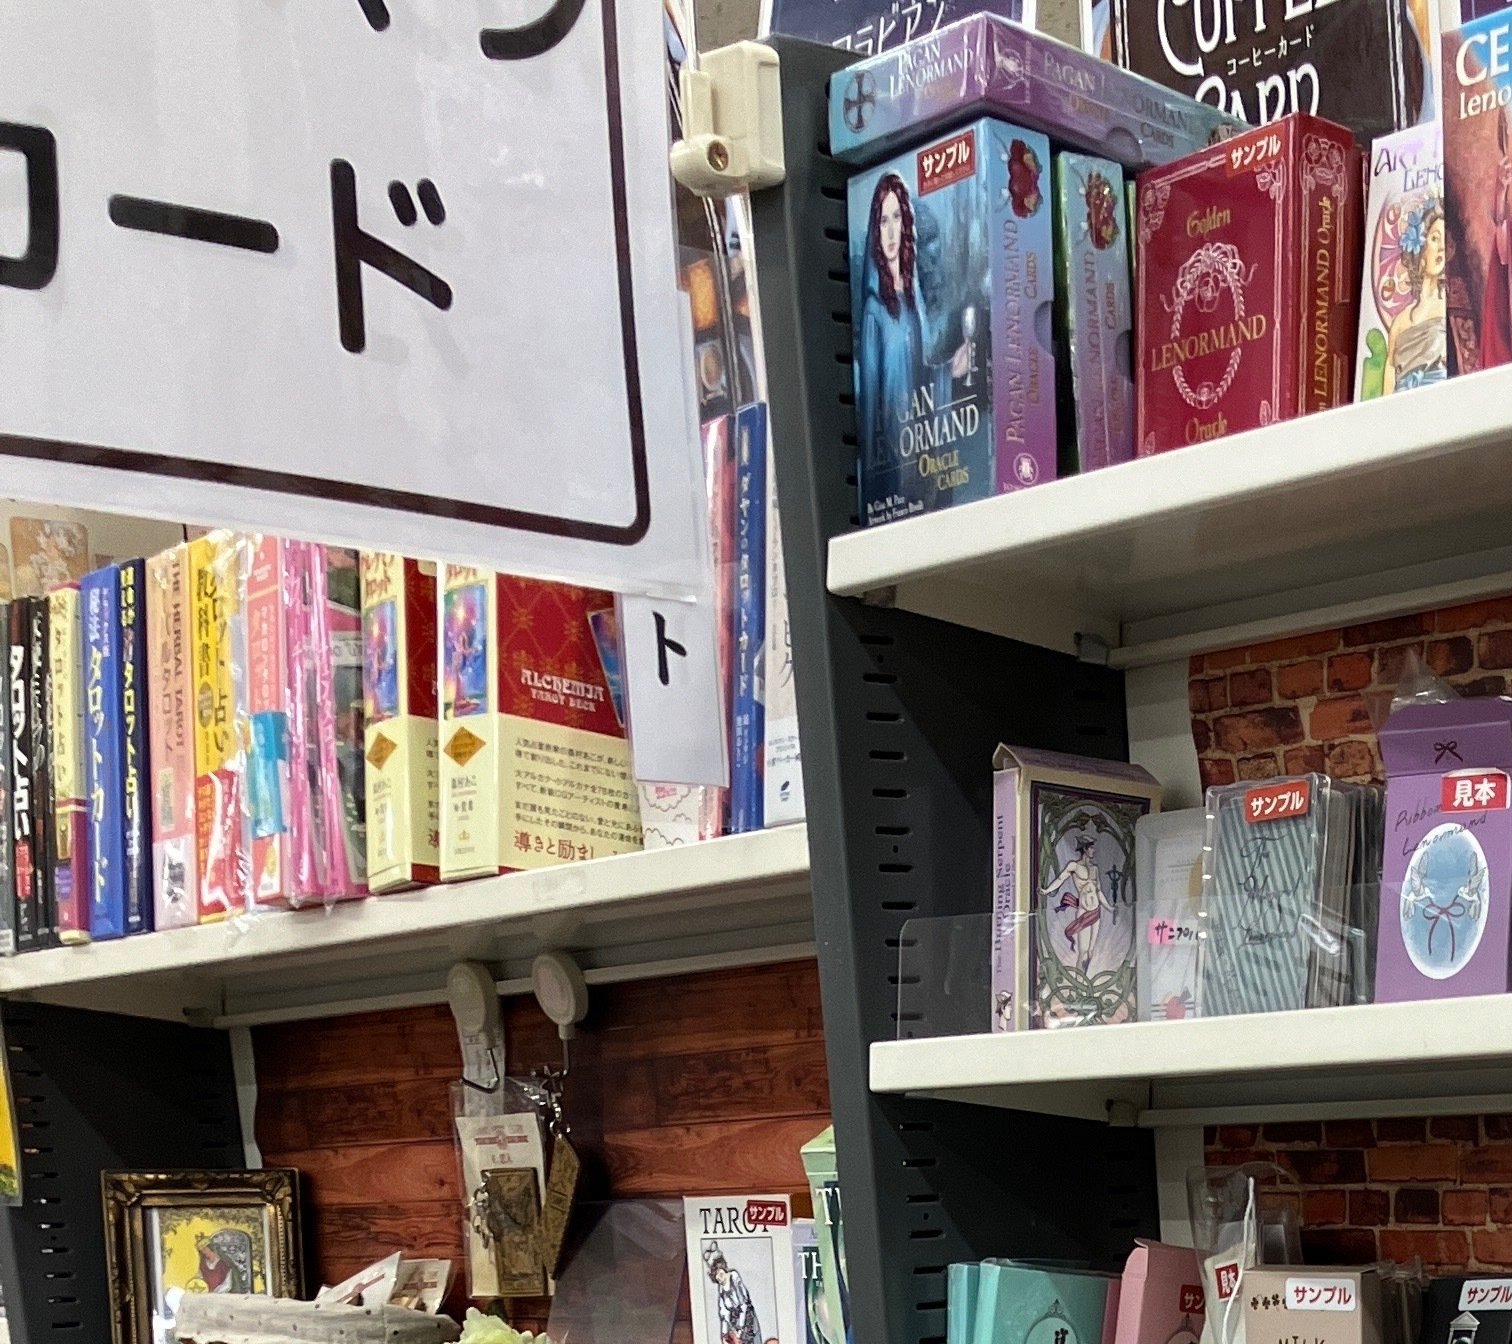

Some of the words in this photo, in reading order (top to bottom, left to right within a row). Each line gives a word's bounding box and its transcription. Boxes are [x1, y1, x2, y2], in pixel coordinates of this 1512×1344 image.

[922, 144, 970, 177] サンプル
[1229, 135, 1282, 170] サンプル
[1150, 313, 1267, 371] LENORMAND
[650, 609, 688, 687] ト
[1250, 790, 1305, 816] サンプル
[1452, 781, 1496, 808] 見本
[1293, 1286, 1352, 1307] サンプル
